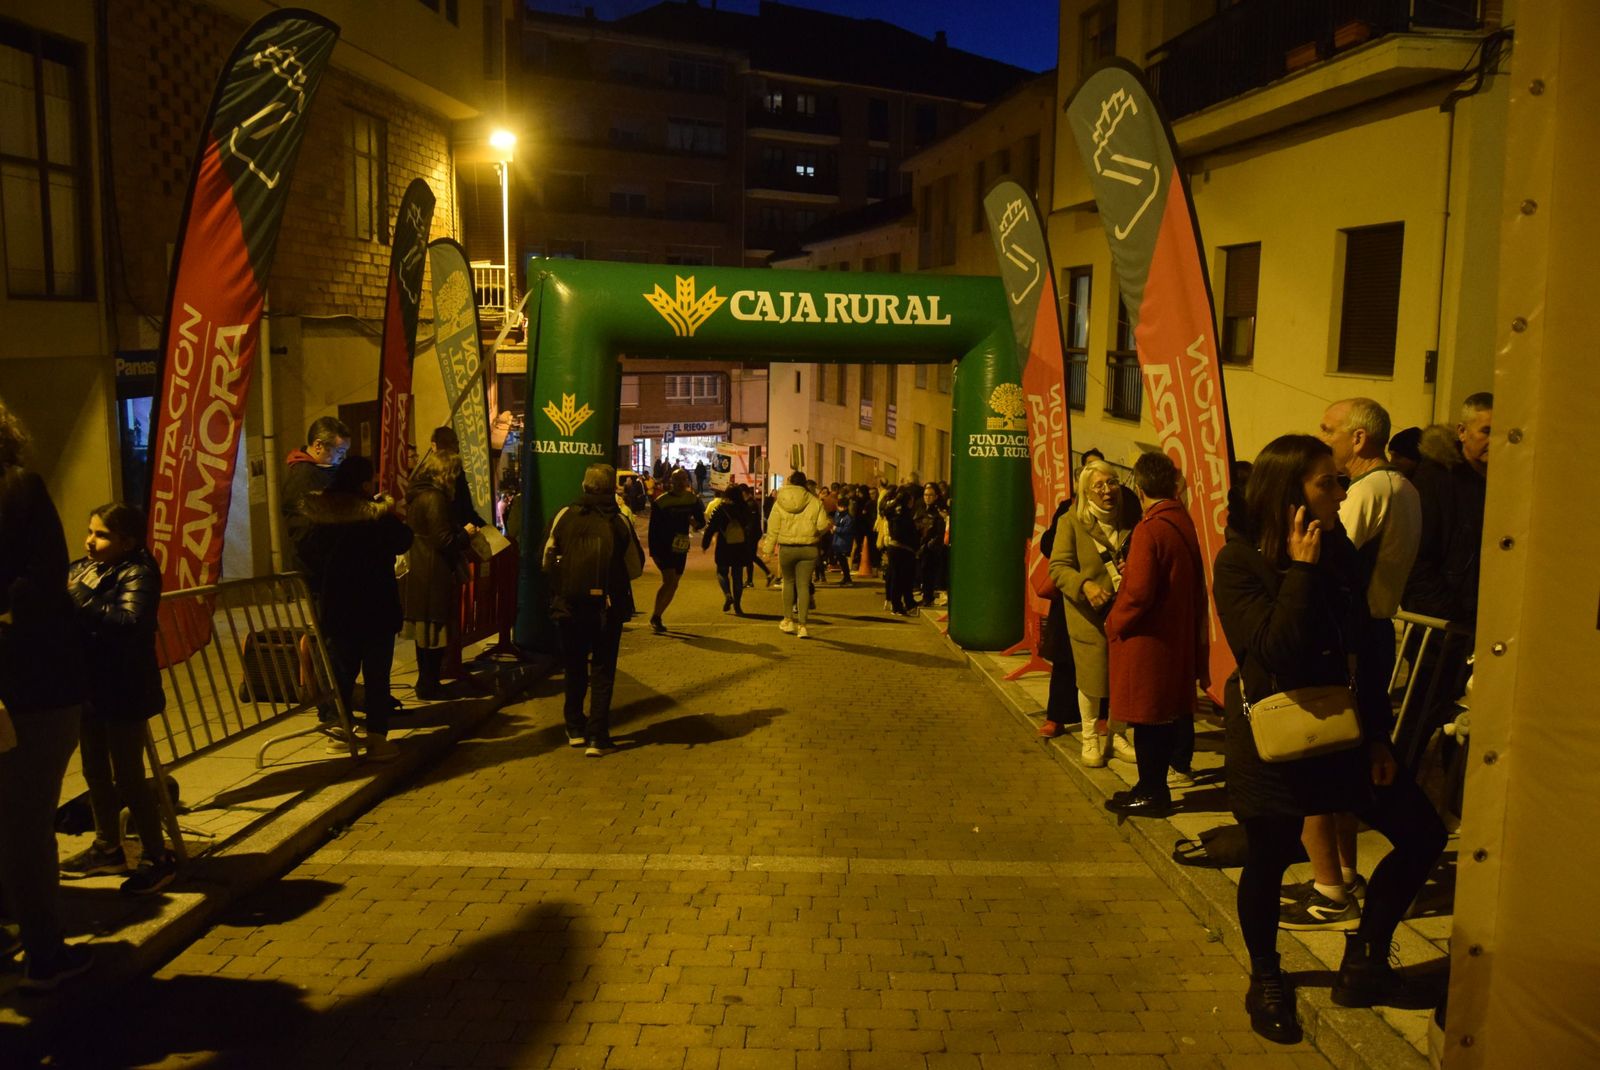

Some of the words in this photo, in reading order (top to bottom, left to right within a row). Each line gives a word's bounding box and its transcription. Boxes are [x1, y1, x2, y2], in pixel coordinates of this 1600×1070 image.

[729, 290, 821, 323] CAJA
[824, 293, 952, 325] RURAL
[673, 423, 682, 432] EL
[684, 423, 707, 431] RIEGO
[666, 431, 674, 441] P
[530, 440, 558, 454] CAJA
[559, 441, 604, 456] RURAL
[969, 446, 1000, 457] CAJA
[179, 324, 249, 604] ZAMORA
